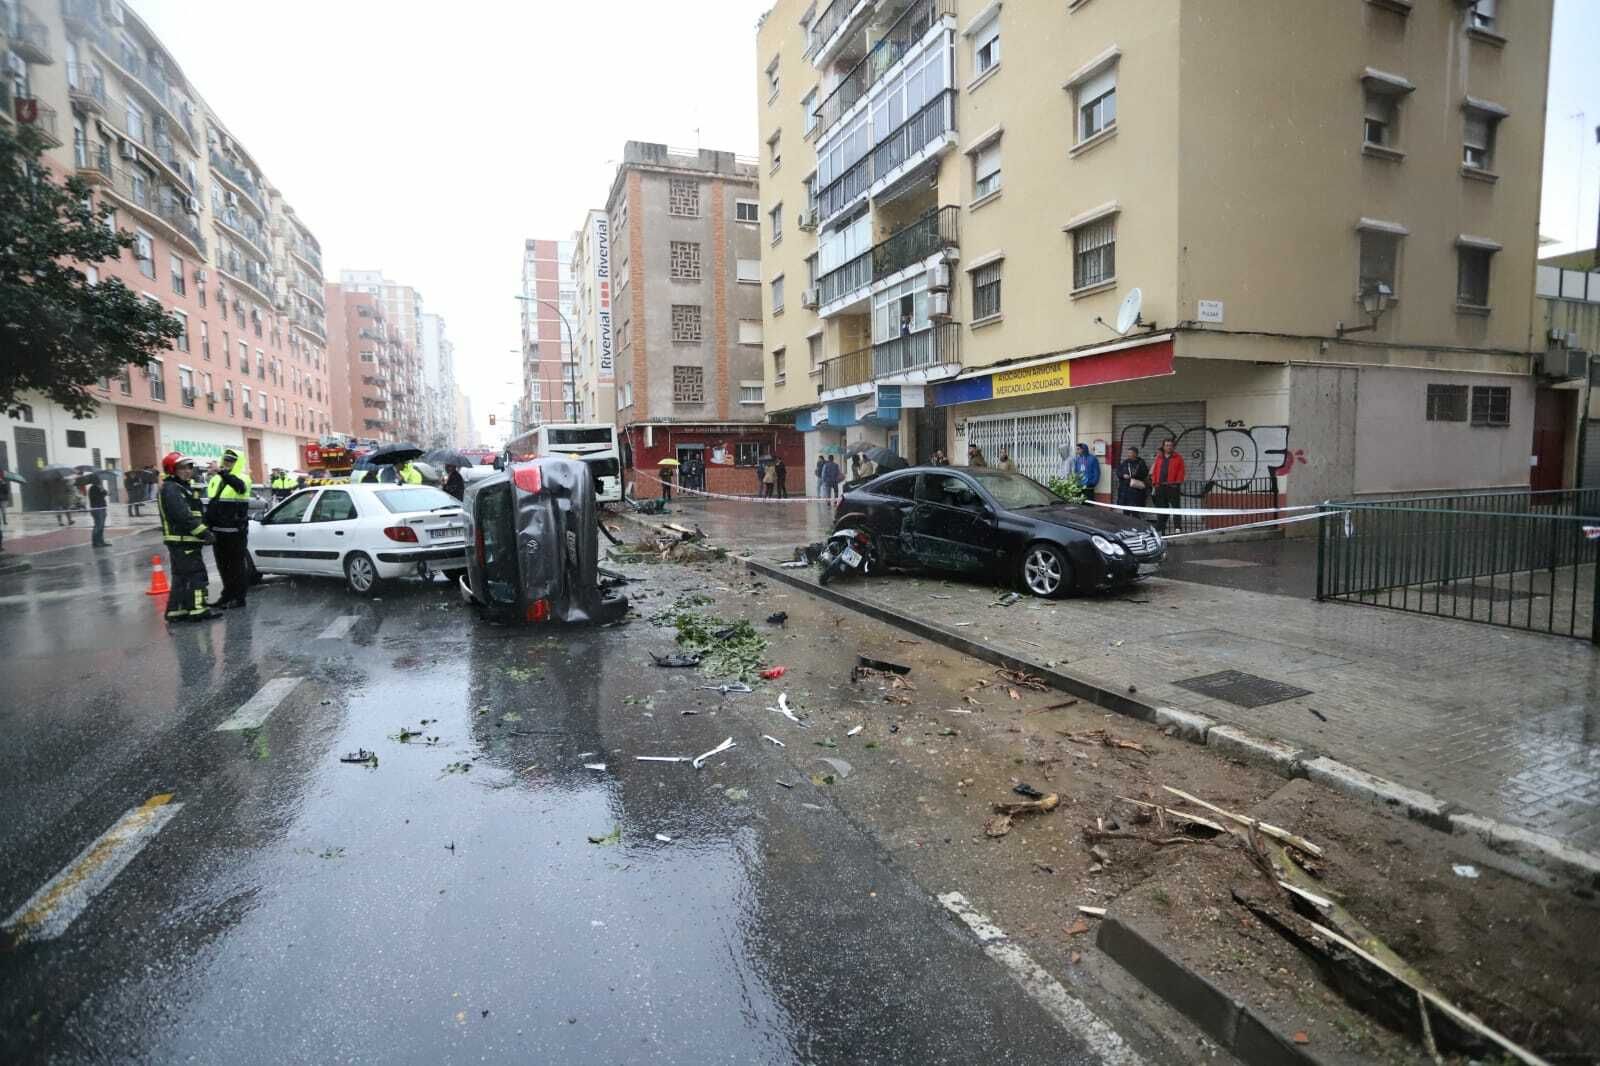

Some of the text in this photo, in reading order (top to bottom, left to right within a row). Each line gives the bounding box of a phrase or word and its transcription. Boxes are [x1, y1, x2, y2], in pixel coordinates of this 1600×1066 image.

[597, 219, 608, 278] Rivervial
[600, 311, 611, 369] Rivervial
[996, 377, 1064, 395] MERCADILLO SOLIDARIO
